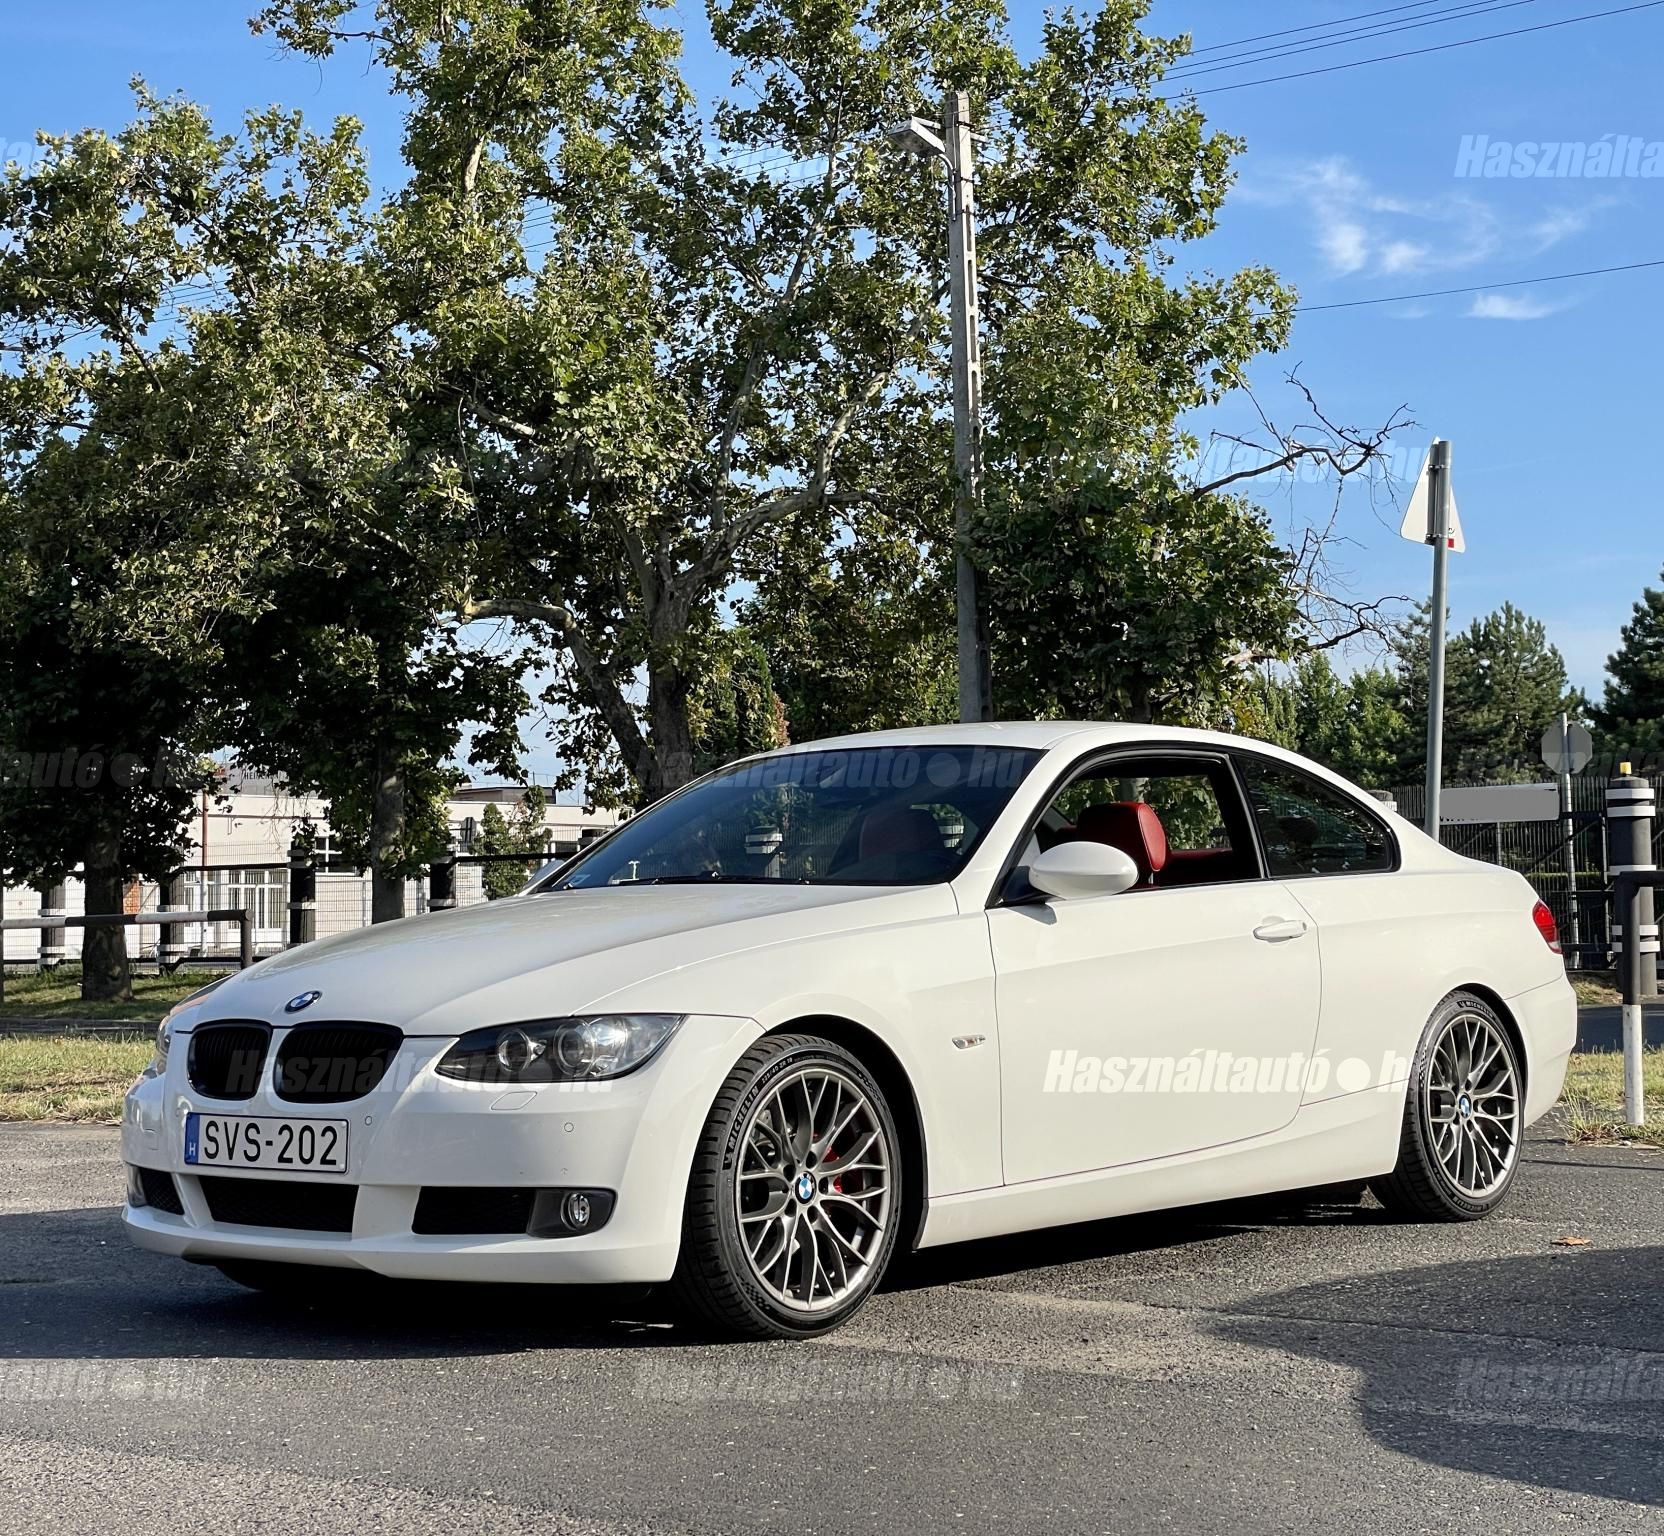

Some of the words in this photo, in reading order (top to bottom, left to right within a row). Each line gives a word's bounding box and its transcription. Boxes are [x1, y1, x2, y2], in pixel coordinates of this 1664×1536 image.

[728, 1084, 759, 1153] MICHELIN
[189, 1142, 197, 1156] H
[204, 1120, 338, 1166] SVS-202
